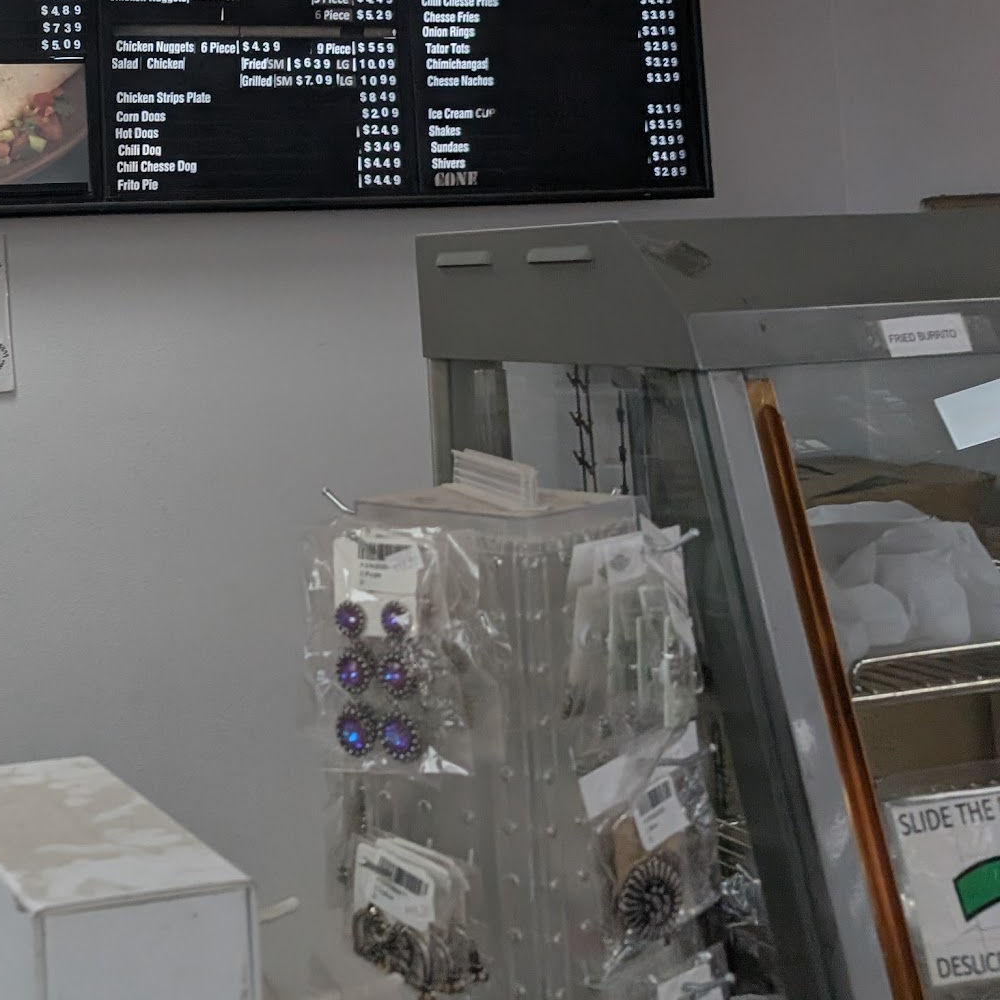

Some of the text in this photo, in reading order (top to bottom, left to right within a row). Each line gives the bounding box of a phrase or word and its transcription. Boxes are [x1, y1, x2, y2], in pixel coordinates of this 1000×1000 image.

[315, 10, 321, 20] 6
[323, 9, 351, 21] Piece
[423, 11, 456, 23] Chesse
[457, 11, 480, 23] Fries
[422, 26, 448, 38] Onion
[449, 26, 476, 39] Rings
[115, 40, 154, 53] Chicken
[156, 41, 195, 54] Nuggets
[200, 43, 207, 53] 6
[209, 42, 236, 54] Piece
[317, 43, 351, 55] 9 Piece
[425, 43, 471, 54] Tator Tots
[111, 57, 139, 70] Salad
[146, 57, 184, 70] Chicken
[268, 59, 284, 70] SM
[336, 59, 350, 70] LG
[426, 58, 487, 71] Chimichangas
[242, 75, 273, 87] Grilled
[275, 76, 293, 87] SM
[339, 76, 354, 86] LG
[427, 75, 460, 87] Chesse
[461, 75, 495, 87] Nachos
[116, 91, 211, 105] Chicken Strips Plate
[116, 111, 139, 122] Corn
[428, 108, 443, 119] Ice
[444, 107, 474, 119] Cream
[475, 108, 496, 119] CUP
[115, 128, 133, 139] Hot
[428, 125, 462, 137] Shakes
[118, 144, 140, 156] Chili
[430, 141, 470, 153] Sundaes
[116, 161, 138, 173] Chili
[140, 160, 176, 172] Chesse
[177, 160, 197, 174] Dog
[431, 158, 466, 169] Shivers
[117, 179, 159, 191] Frito Pie
[898, 799, 996, 837] SLIDE THE
[936, 951, 1000, 979] DESLIC
